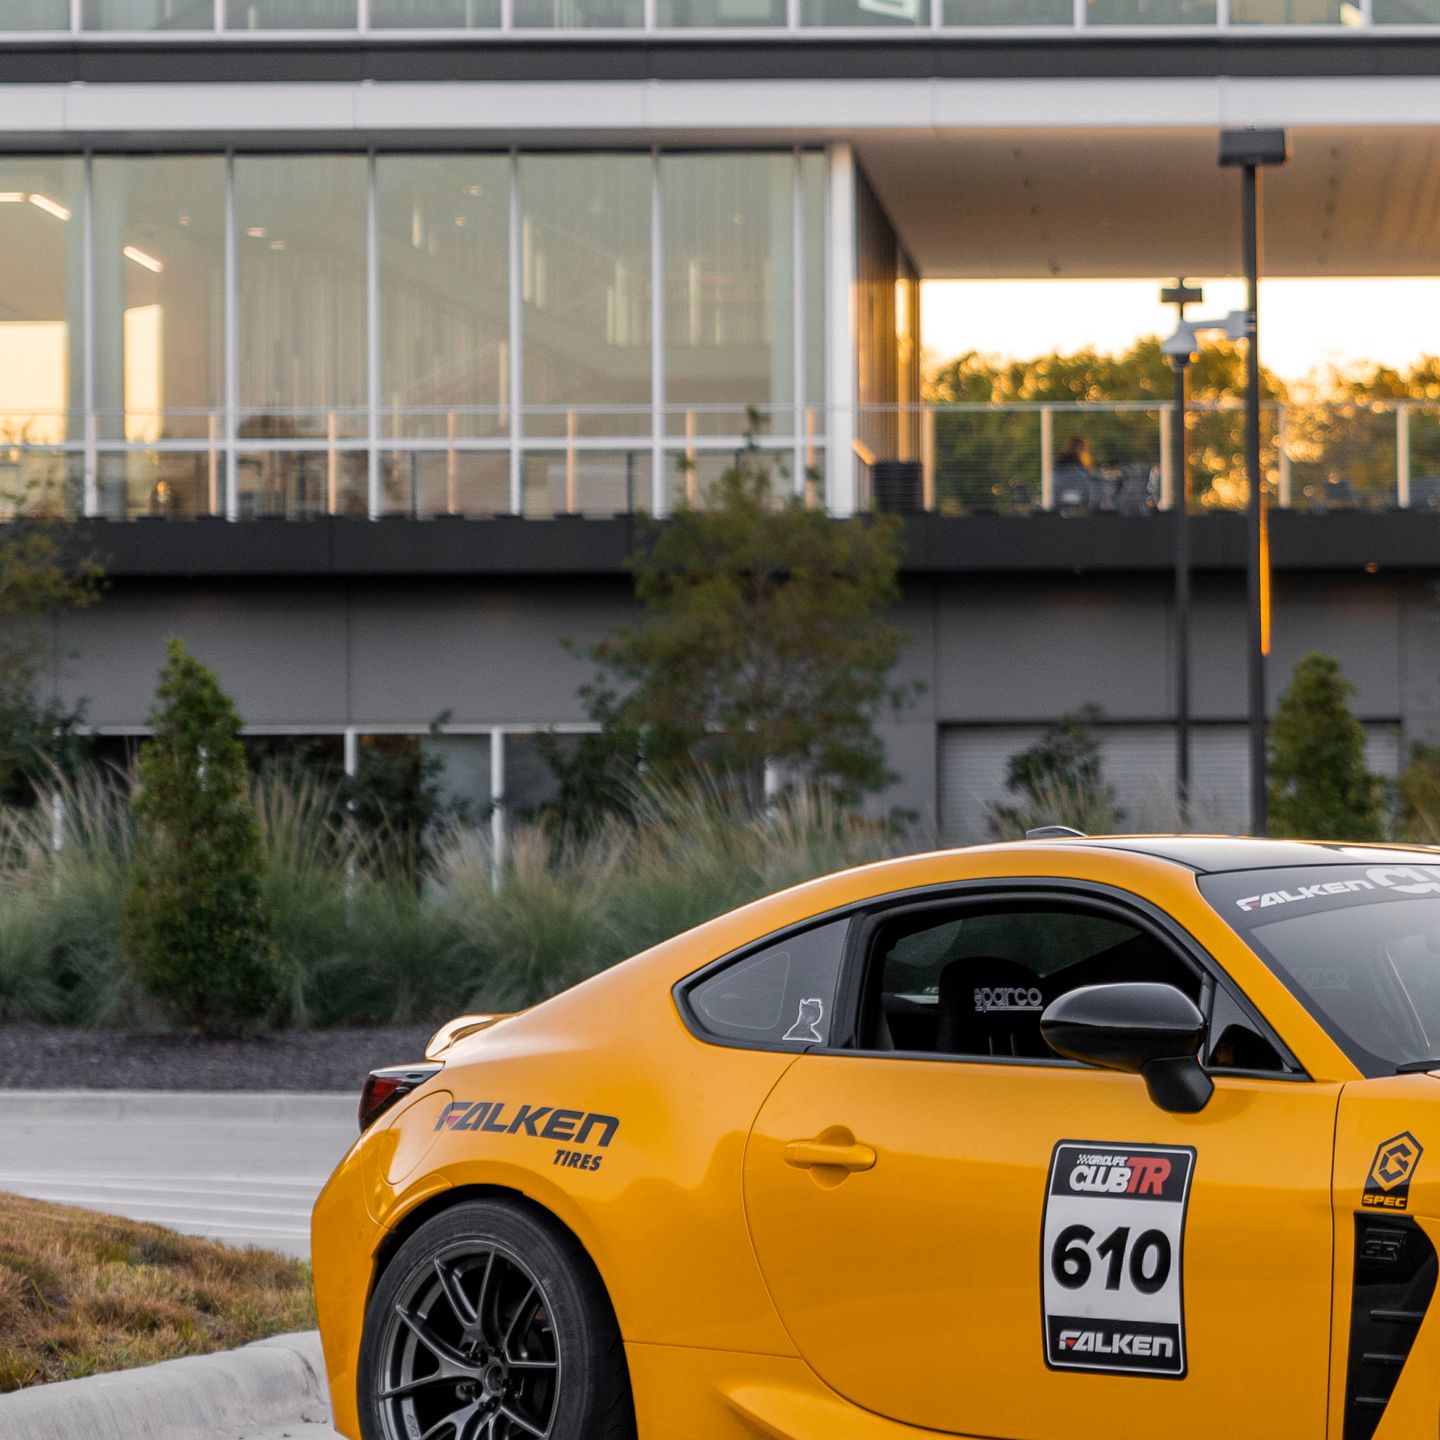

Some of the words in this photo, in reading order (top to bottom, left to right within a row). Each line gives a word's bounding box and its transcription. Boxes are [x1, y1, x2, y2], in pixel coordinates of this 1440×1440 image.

[1236, 879, 1375, 912] FALKEN
[434, 1101, 620, 1148] FALKEN
[553, 1149, 602, 1172] TIRES
[1088, 1155, 1128, 1167] GRIDLIFE
[1362, 1194, 1407, 1208] SPEC
[1051, 1224, 1172, 1296] 610
[1057, 1329, 1174, 1358] FALKEN
